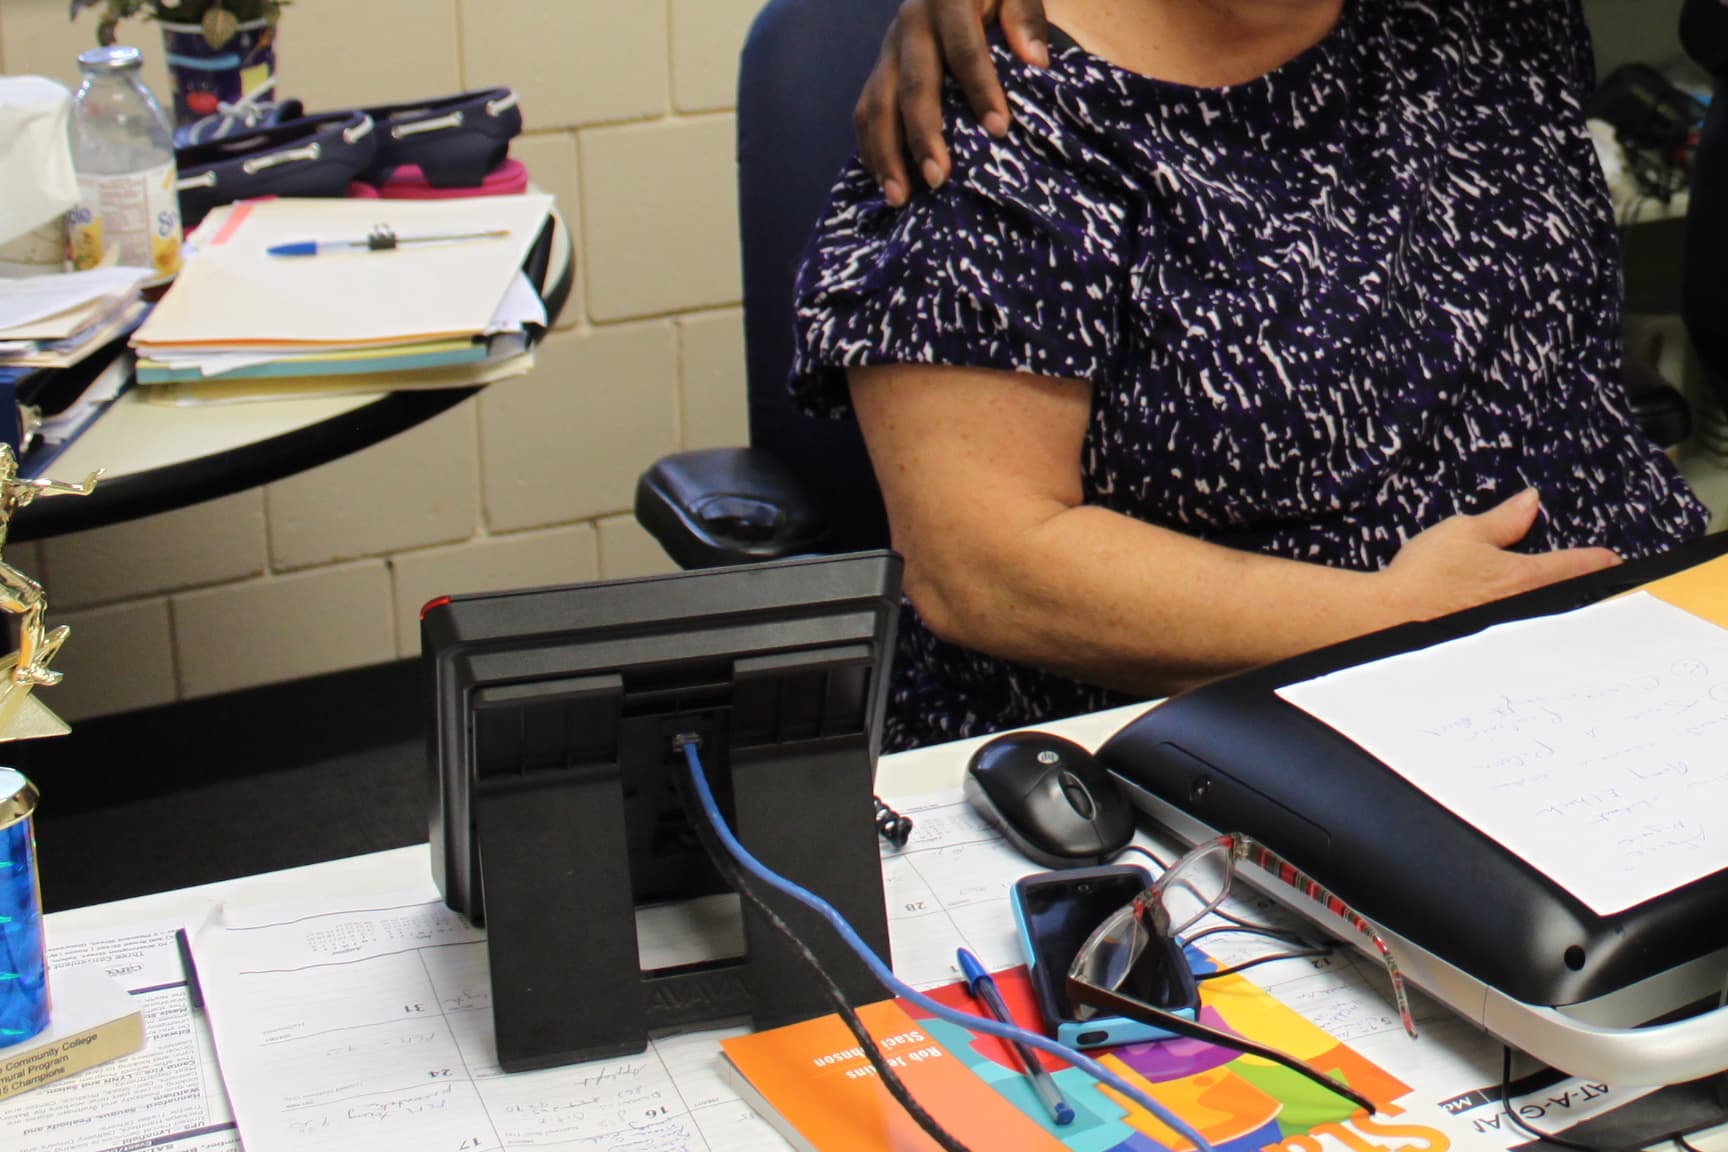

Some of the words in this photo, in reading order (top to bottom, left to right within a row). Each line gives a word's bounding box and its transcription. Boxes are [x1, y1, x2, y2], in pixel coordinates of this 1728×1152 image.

[880, 1029, 926, 1051] Staci
[5, 1047, 60, 1071] Community
[62, 1033, 98, 1052] College
[907, 1045, 943, 1063] Rob
[28, 1053, 69, 1074] Program
[11, 1066, 66, 1090] Champions
[645, 1105, 669, 1118] 16
